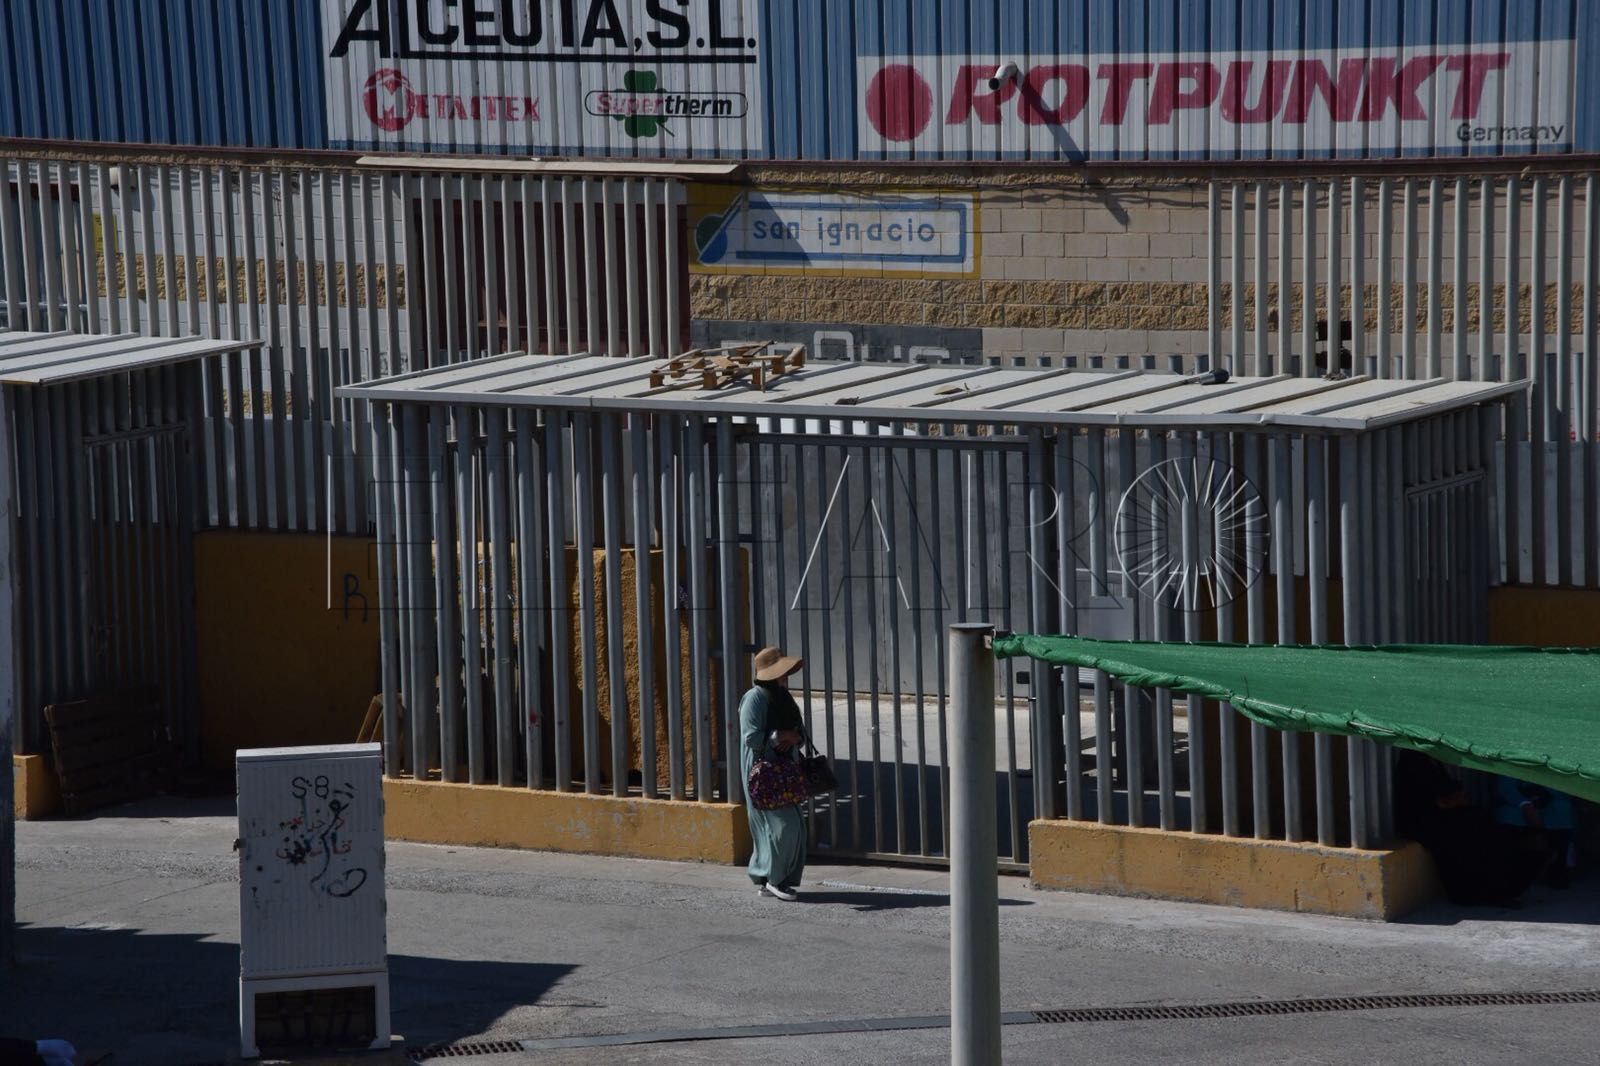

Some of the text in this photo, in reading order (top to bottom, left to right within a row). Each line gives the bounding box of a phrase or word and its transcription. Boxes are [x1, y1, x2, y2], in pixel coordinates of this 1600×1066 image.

[945, 53, 1510, 125] ROTPUNKT
[596, 93, 733, 117] Supertherm
[1456, 122, 1565, 143] Germany
[753, 217, 935, 246] san ignacio
